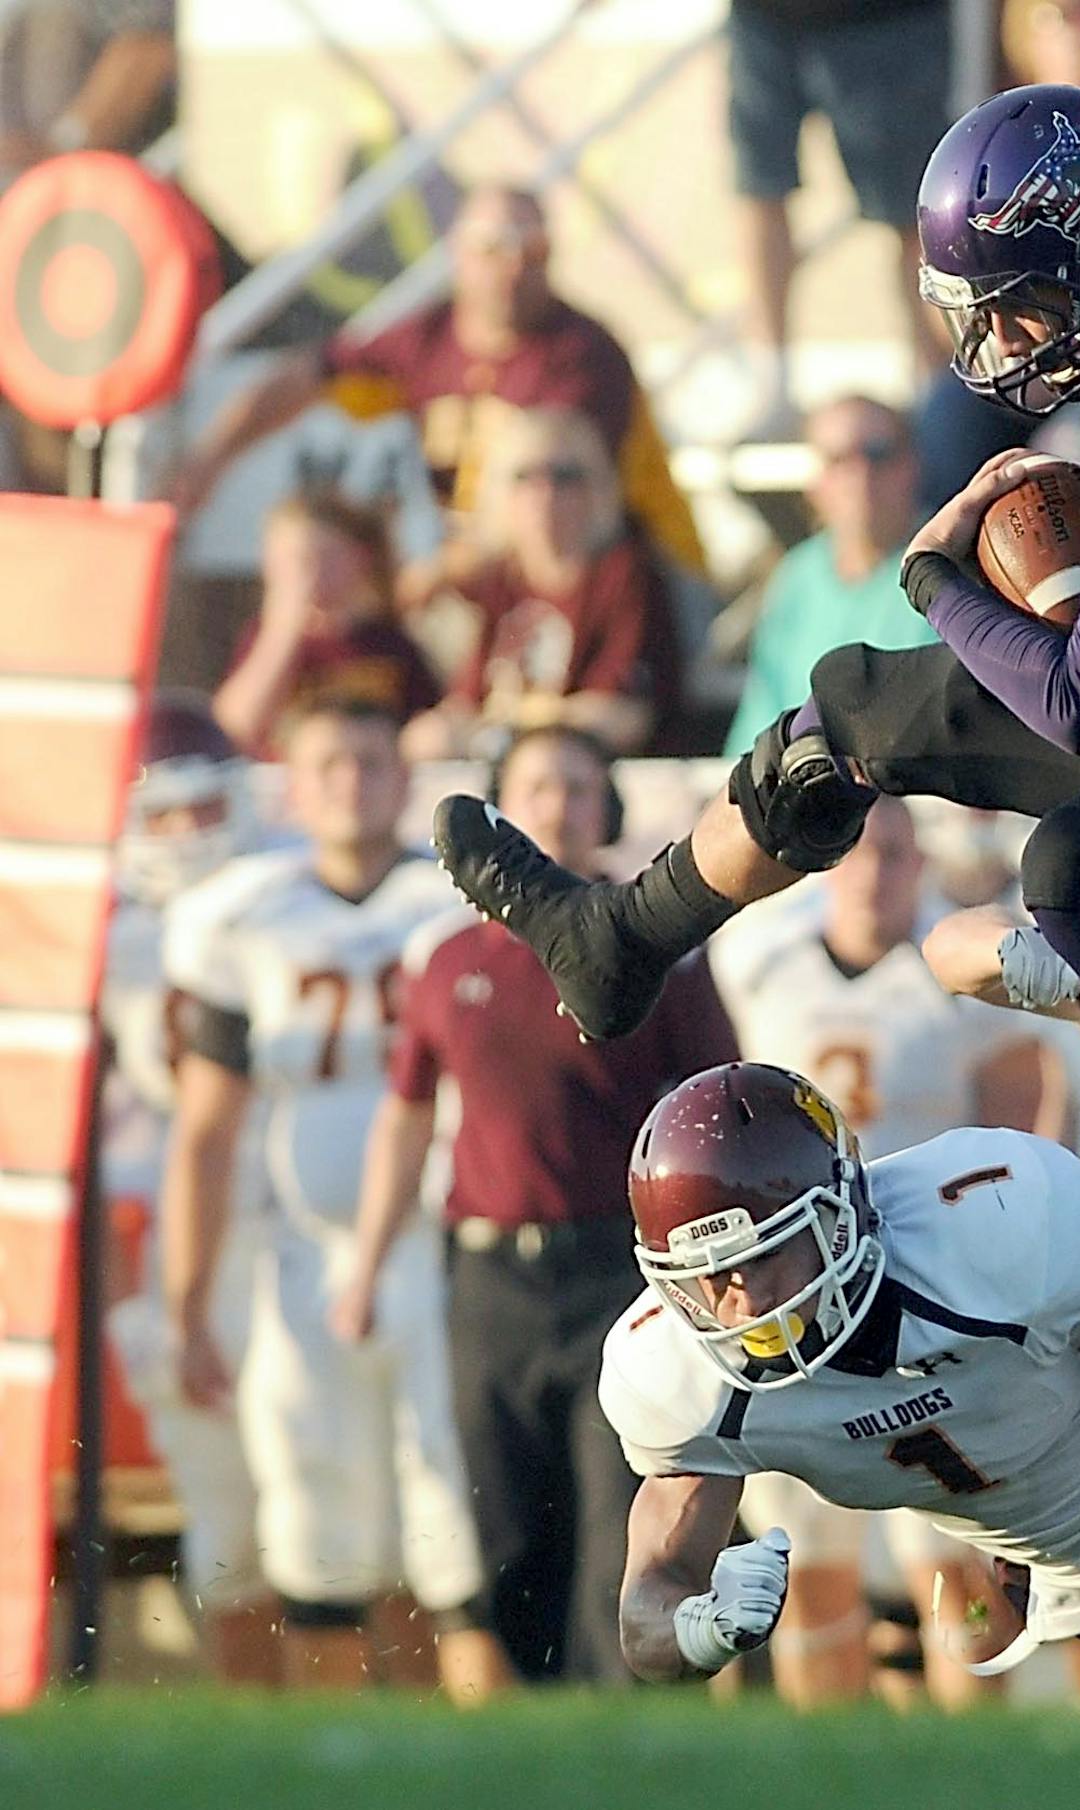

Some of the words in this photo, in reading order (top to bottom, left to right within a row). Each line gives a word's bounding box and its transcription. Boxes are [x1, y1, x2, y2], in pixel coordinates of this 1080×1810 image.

[1007, 507, 1025, 539] NCAA
[1038, 473, 1070, 543] Wilson
[690, 1217, 729, 1240] DOGS
[661, 1280, 702, 1316] iddell
[842, 1386, 955, 1440] BULLDOGS
[885, 1423, 1004, 1495] 1
